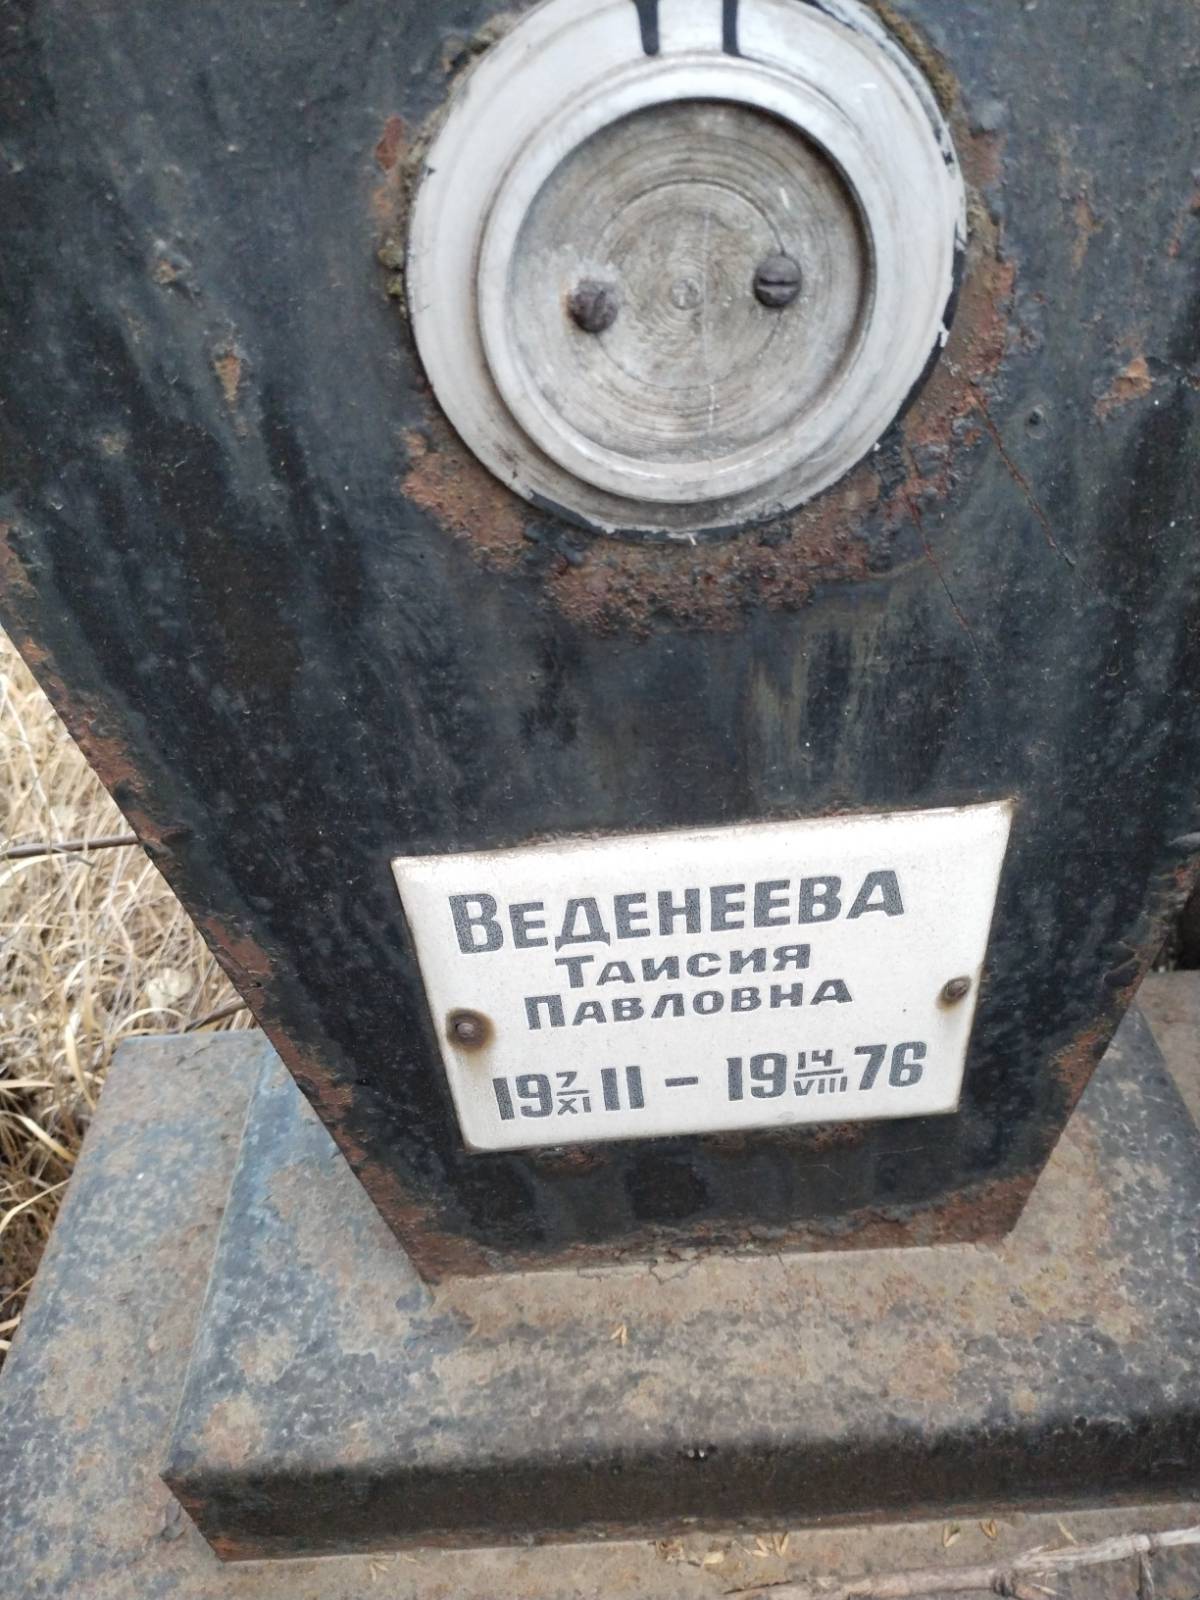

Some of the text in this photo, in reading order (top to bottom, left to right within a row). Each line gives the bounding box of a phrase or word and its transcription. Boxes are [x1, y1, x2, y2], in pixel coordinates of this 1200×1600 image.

[449, 869, 905, 955] ВЕДЕНЕЕВА
[554, 943, 811, 989] ТАИСИЯ
[523, 978, 853, 1031] ПАВЛОВНА
